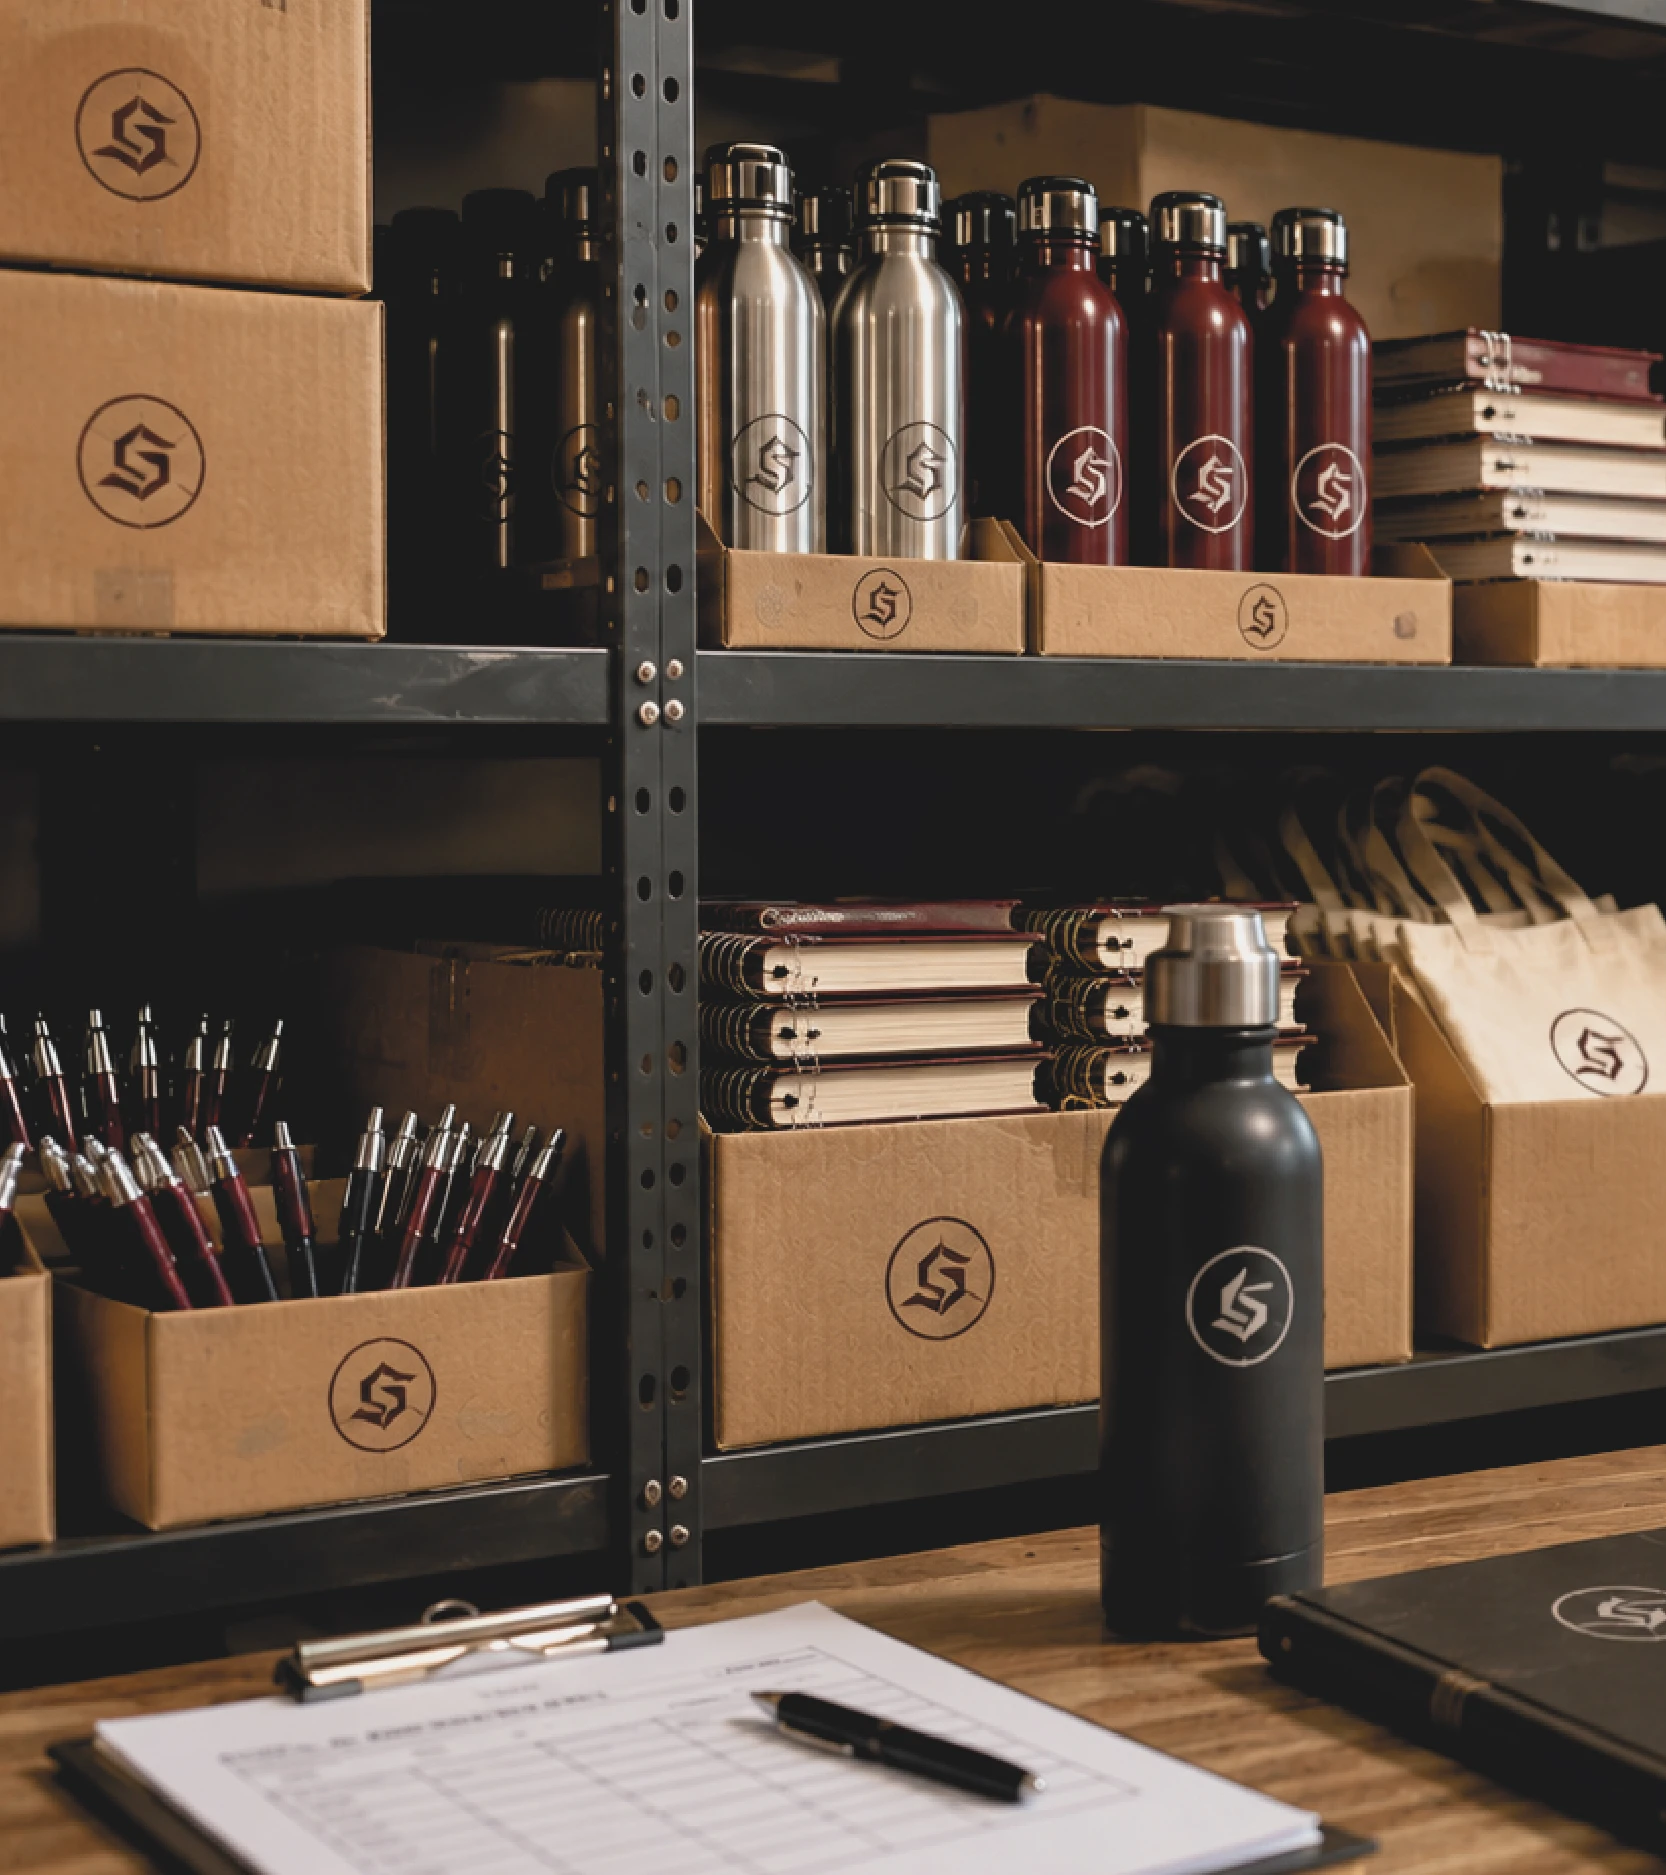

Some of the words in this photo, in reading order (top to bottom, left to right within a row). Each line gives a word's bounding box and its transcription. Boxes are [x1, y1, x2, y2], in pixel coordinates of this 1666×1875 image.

[93, 97, 175, 175] S
[97, 424, 175, 500] S
[747, 436, 800, 495] S
[890, 442, 947, 499] S
[1066, 447, 1112, 505] S
[1189, 454, 1237, 512] S
[1309, 462, 1351, 520] S
[859, 580, 903, 626] S
[1244, 597, 1276, 639] S
[1577, 1028, 1623, 1080] S
[901, 1243, 971, 1315] S
[1212, 1268, 1272, 1341] S
[351, 1362, 417, 1429] S
